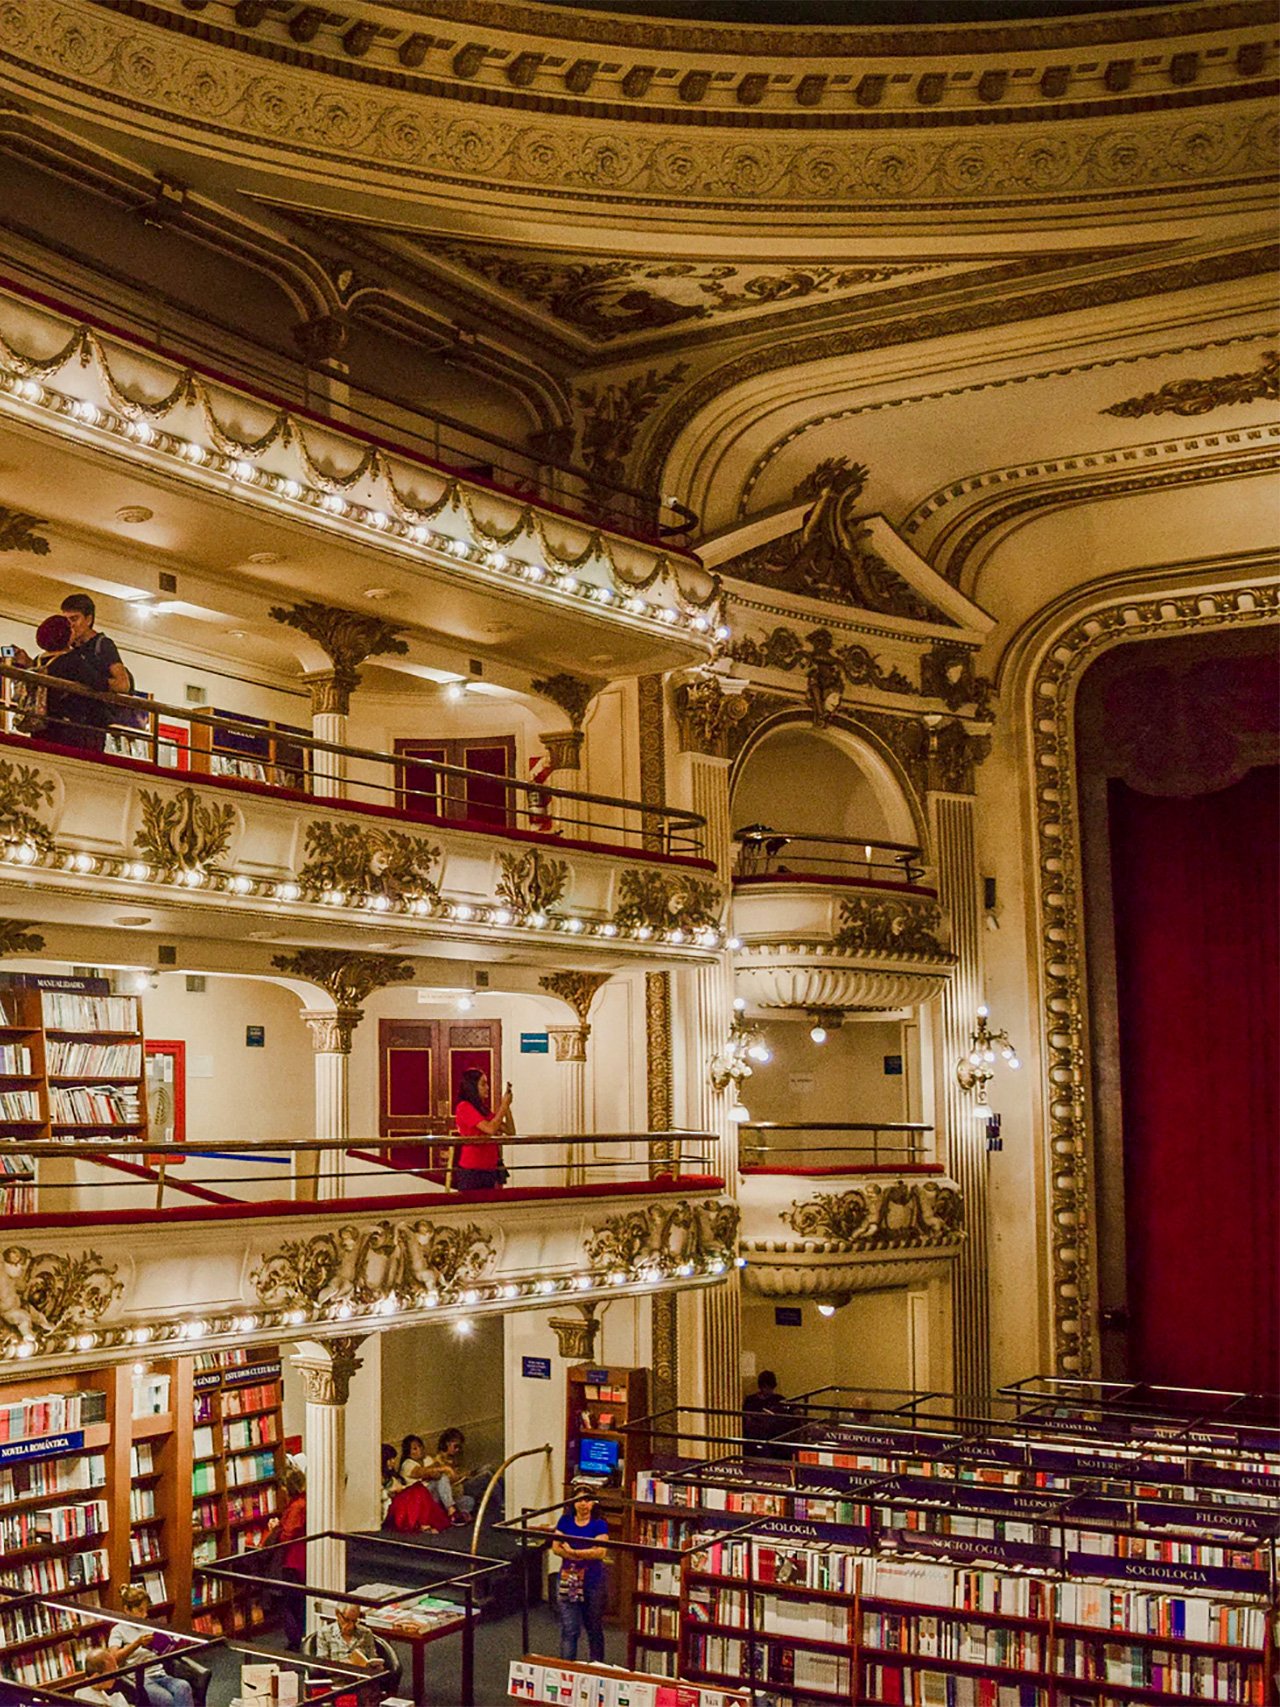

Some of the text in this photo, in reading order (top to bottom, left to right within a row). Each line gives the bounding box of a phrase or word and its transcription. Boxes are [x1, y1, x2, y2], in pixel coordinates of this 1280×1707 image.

[37, 979, 86, 989] MANUALIDADES
[1, 1437, 69, 1458] NOVELA ROMÁNTICA
[824, 1432, 895, 1447] ANTROPOLOGIA
[1196, 1512, 1257, 1529] FILOSOFIA
[932, 1539, 1006, 1557] SOCIOLOGIA
[1125, 1564, 1207, 1582] SOCIOLOGIA
